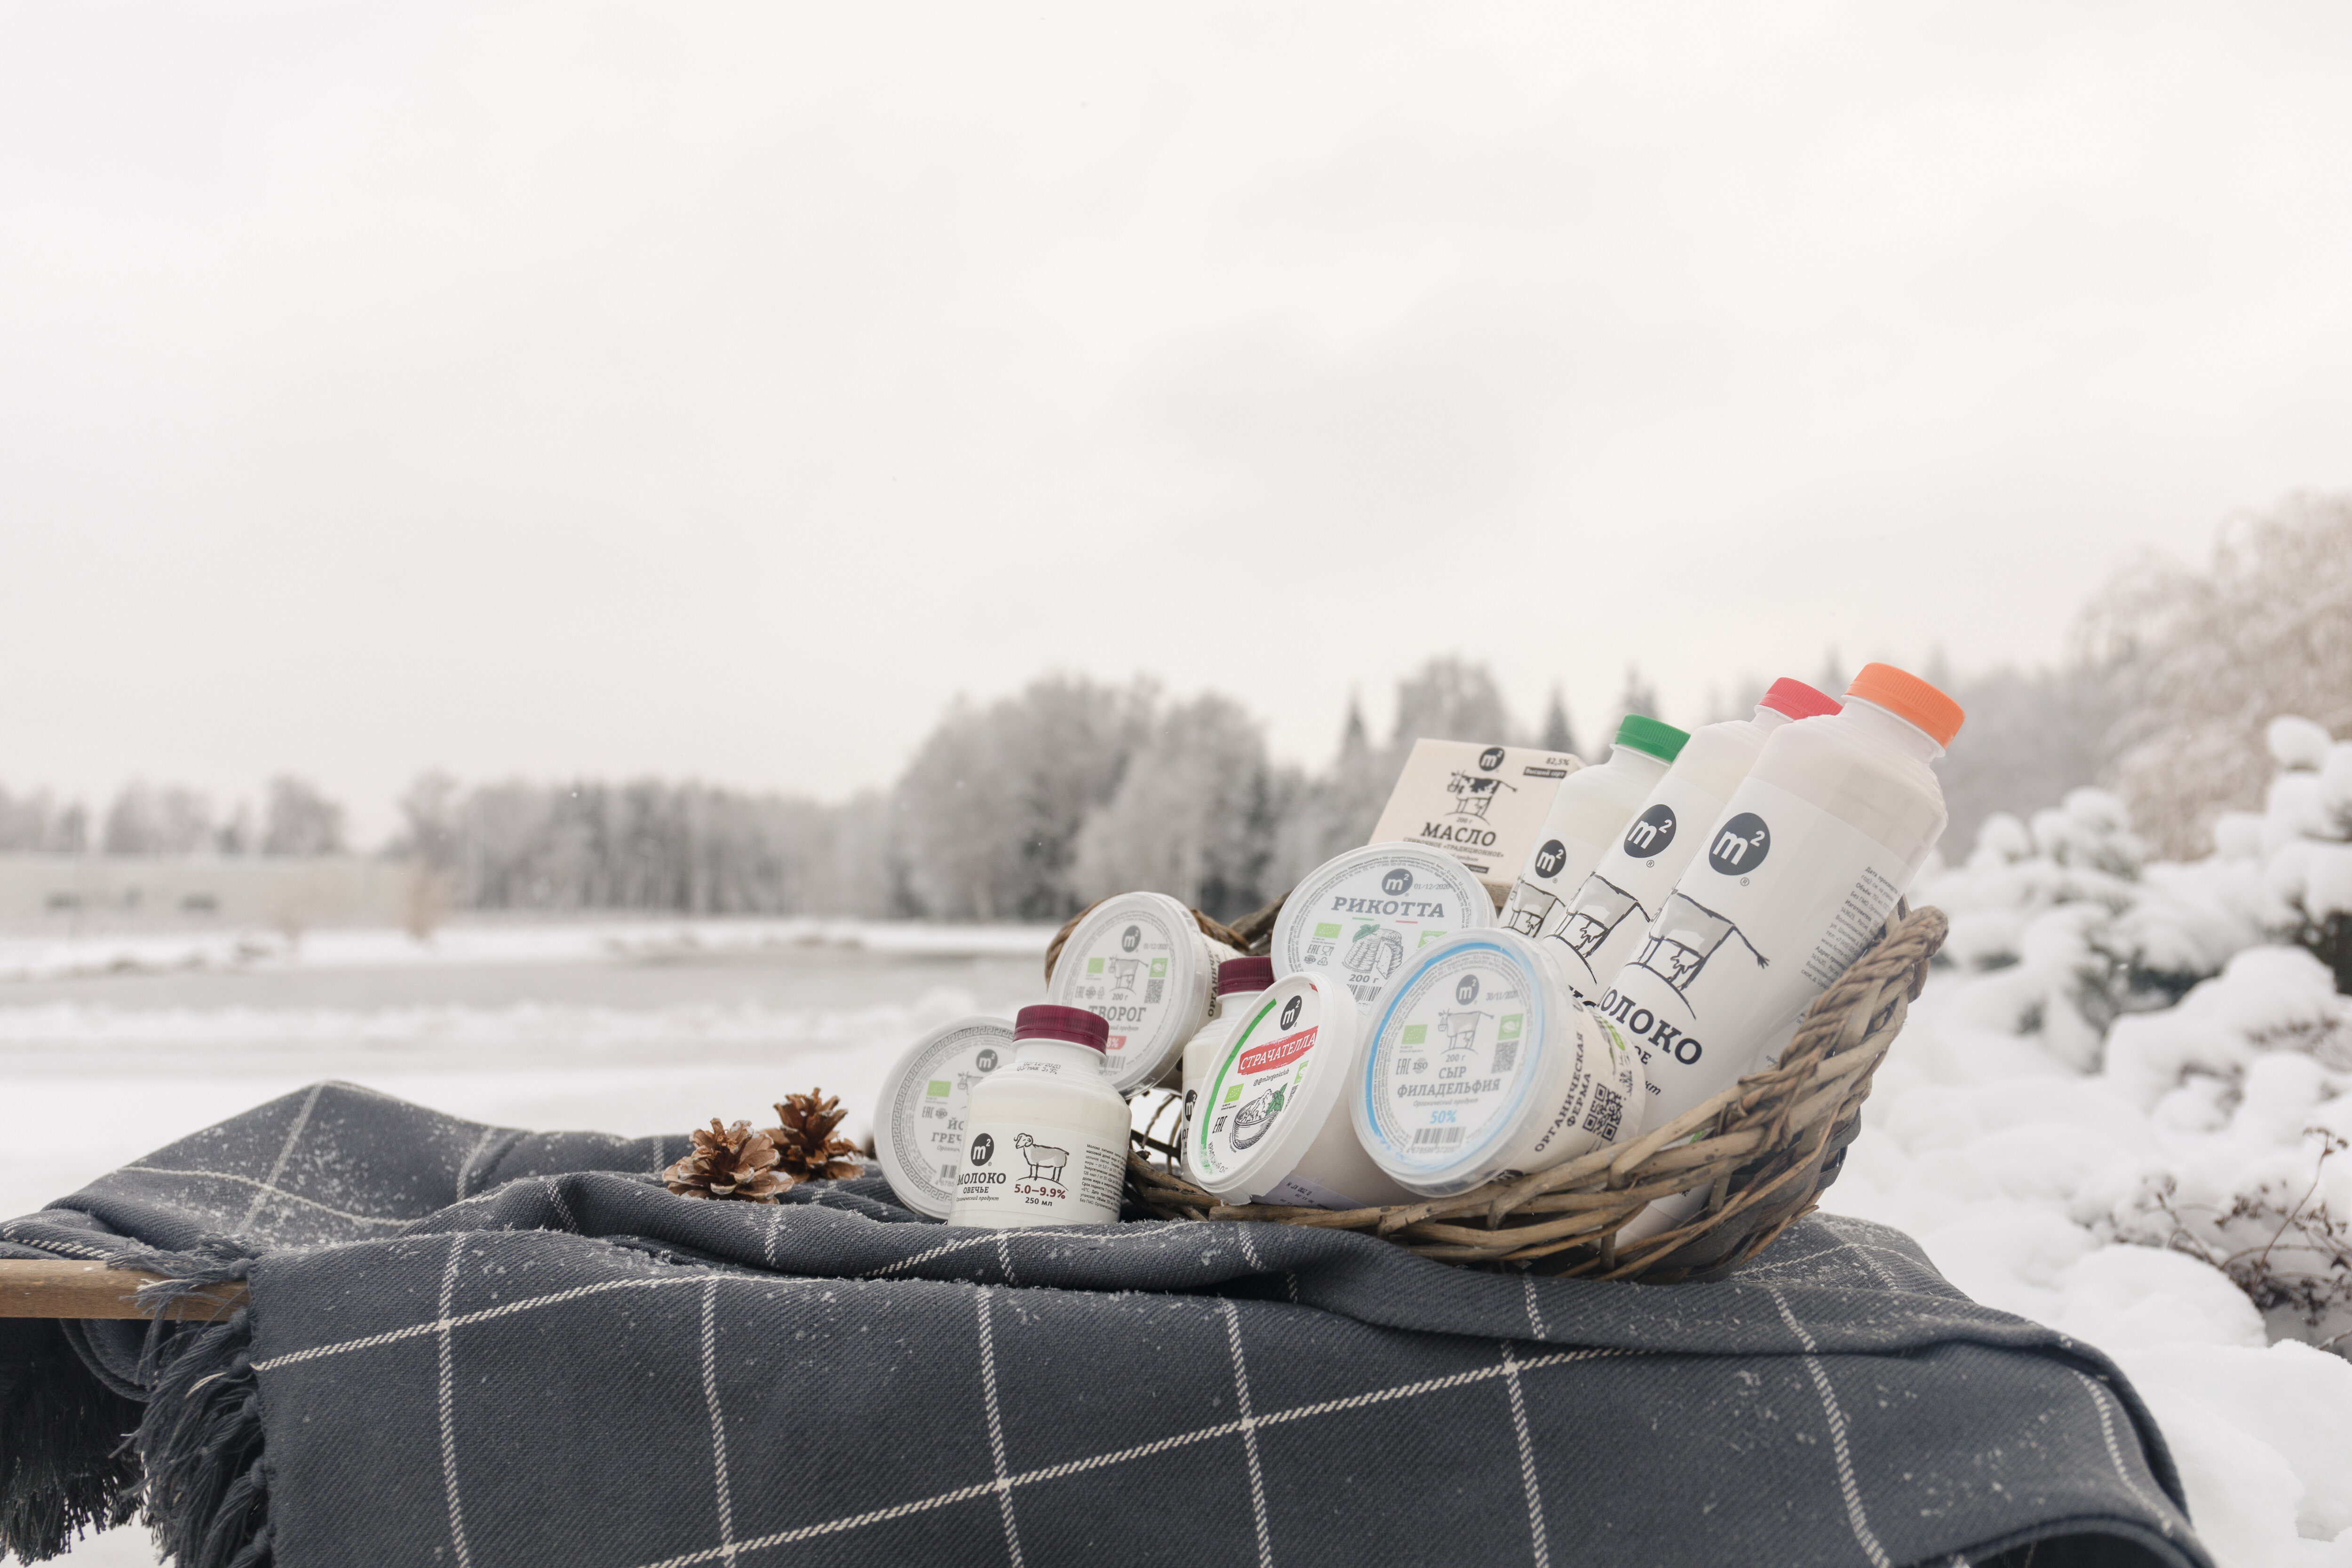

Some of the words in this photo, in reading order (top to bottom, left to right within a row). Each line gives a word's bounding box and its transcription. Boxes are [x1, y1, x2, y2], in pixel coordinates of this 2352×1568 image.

[1546, 757, 1570, 766] 82,5%
[1420, 822, 1496, 846] МАСЛО
[1865, 866, 1878, 877] Дата
[1331, 896, 1444, 917] РИКОТТА
[1815, 946, 1830, 958] Адрес
[1349, 974, 1370, 983] 200
[1089, 1005, 1147, 1022] ТВОРОГ
[1597, 987, 1702, 1065] ОЛОКО
[1240, 1032, 1316, 1070] СТРАЧАТЕЛЛА
[1413, 1062, 1428, 1070] ISO
[1438, 1066, 1467, 1079] СЫР
[1397, 1078, 1501, 1098] ФИЛАДЕЛЬФИЯ
[1534, 1031, 1584, 1153] ОРГАНИЧЕСКАЯ
[1566, 1073, 1591, 1127] ФЕРМА
[1430, 1109, 1457, 1124] 50%
[1084, 1165, 1108, 1175] Энергетическая
[957, 1172, 1006, 1186] МОЛОКО
